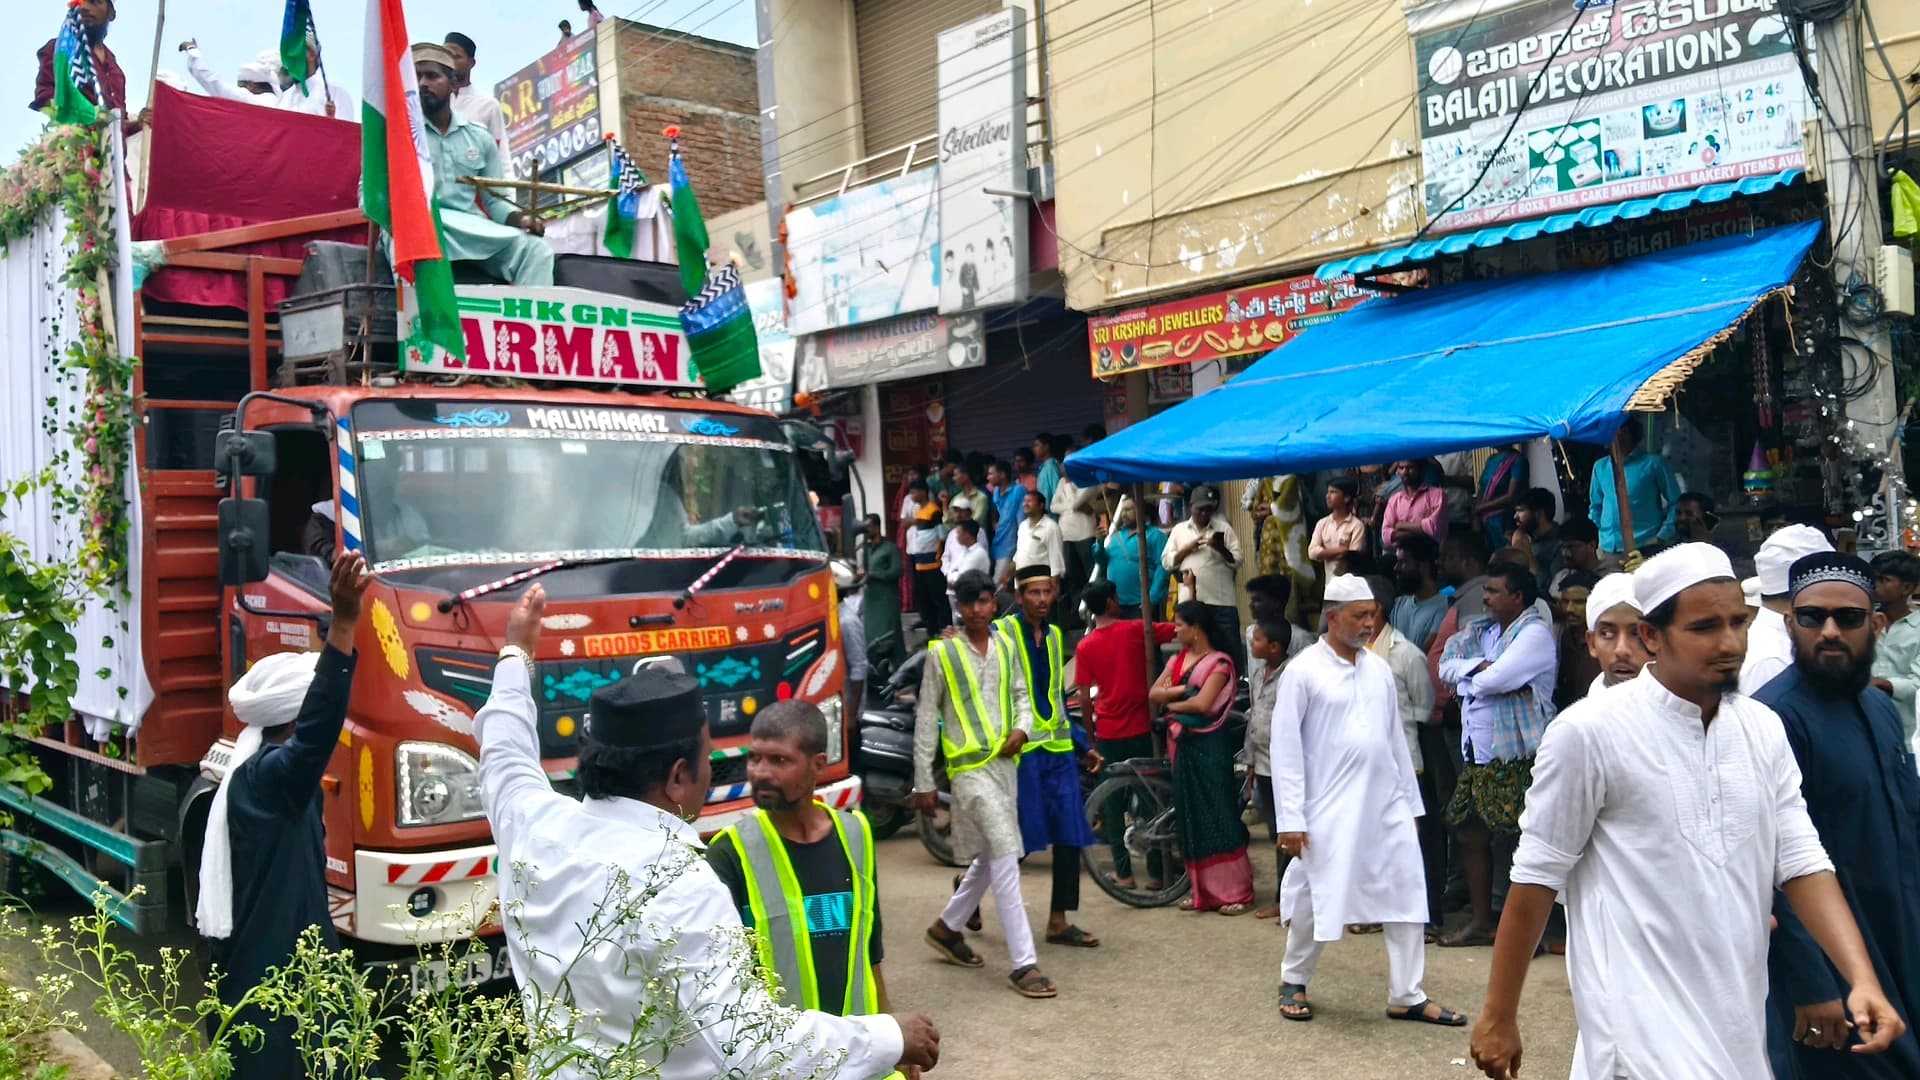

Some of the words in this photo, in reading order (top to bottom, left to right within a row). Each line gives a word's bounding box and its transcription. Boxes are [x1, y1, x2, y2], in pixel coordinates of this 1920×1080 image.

[1426, 76, 1518, 127] BALAJI
[1527, 22, 1742, 104] DECORATIONS
[941, 119, 1011, 163] Selections
[1580, 187, 1609, 202] CAKE
[1611, 178, 1667, 198] MATERIAL
[1668, 173, 1689, 187] ALL
[1690, 163, 1737, 184] BAKERY
[1739, 157, 1776, 175] ITEMS
[1159, 304, 1224, 336] JEWELLERS
[587, 632, 651, 657] GOODS
[656, 628, 730, 650] CARRIER
